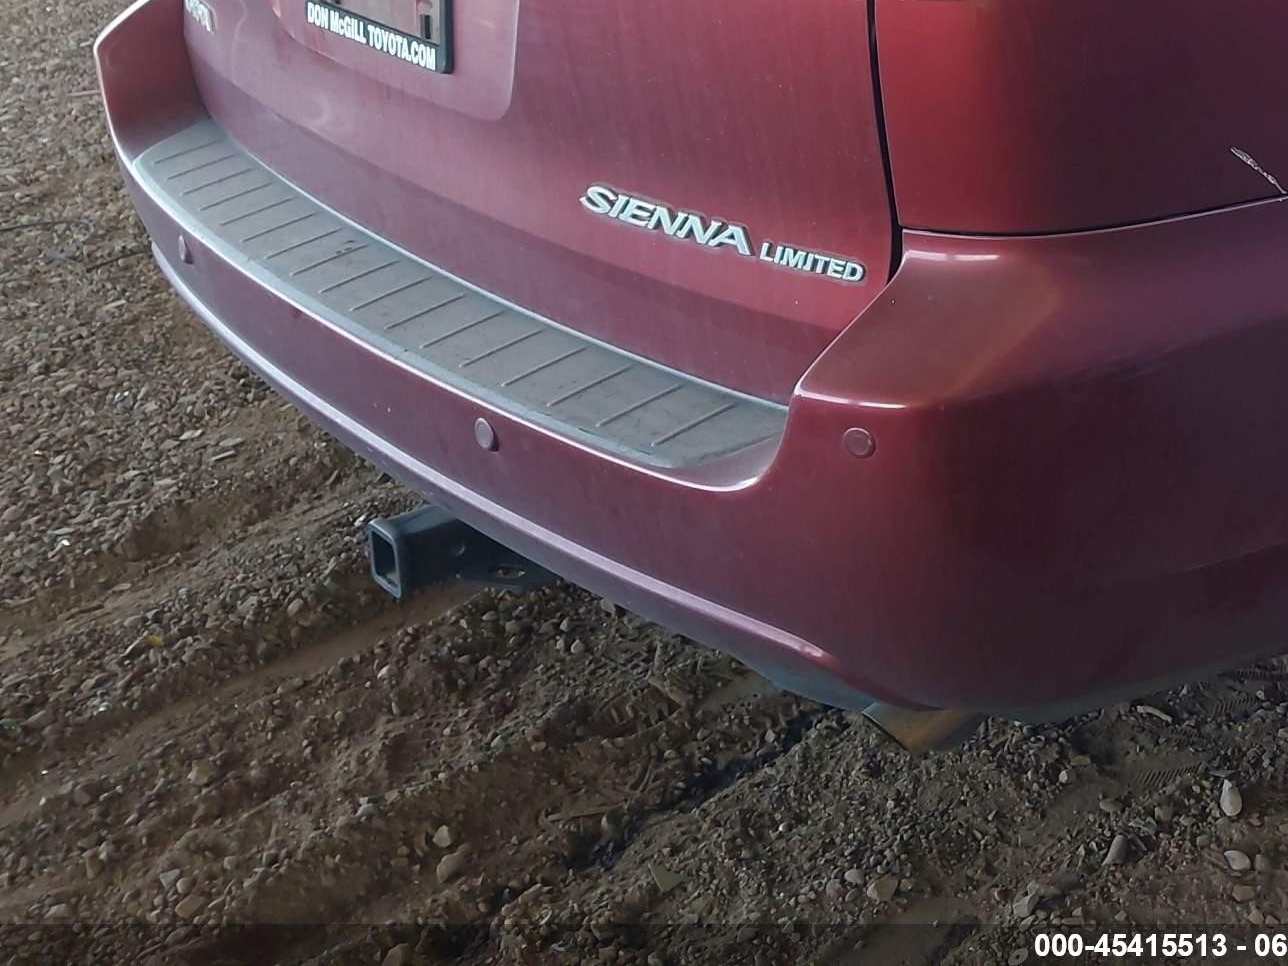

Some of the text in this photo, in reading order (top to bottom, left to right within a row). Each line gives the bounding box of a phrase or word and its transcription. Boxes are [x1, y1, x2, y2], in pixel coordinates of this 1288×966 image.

[307, 3, 436, 71] DON McGILL TOYOTA.COM
[580, 186, 864, 282] SIENNA LIMITED
